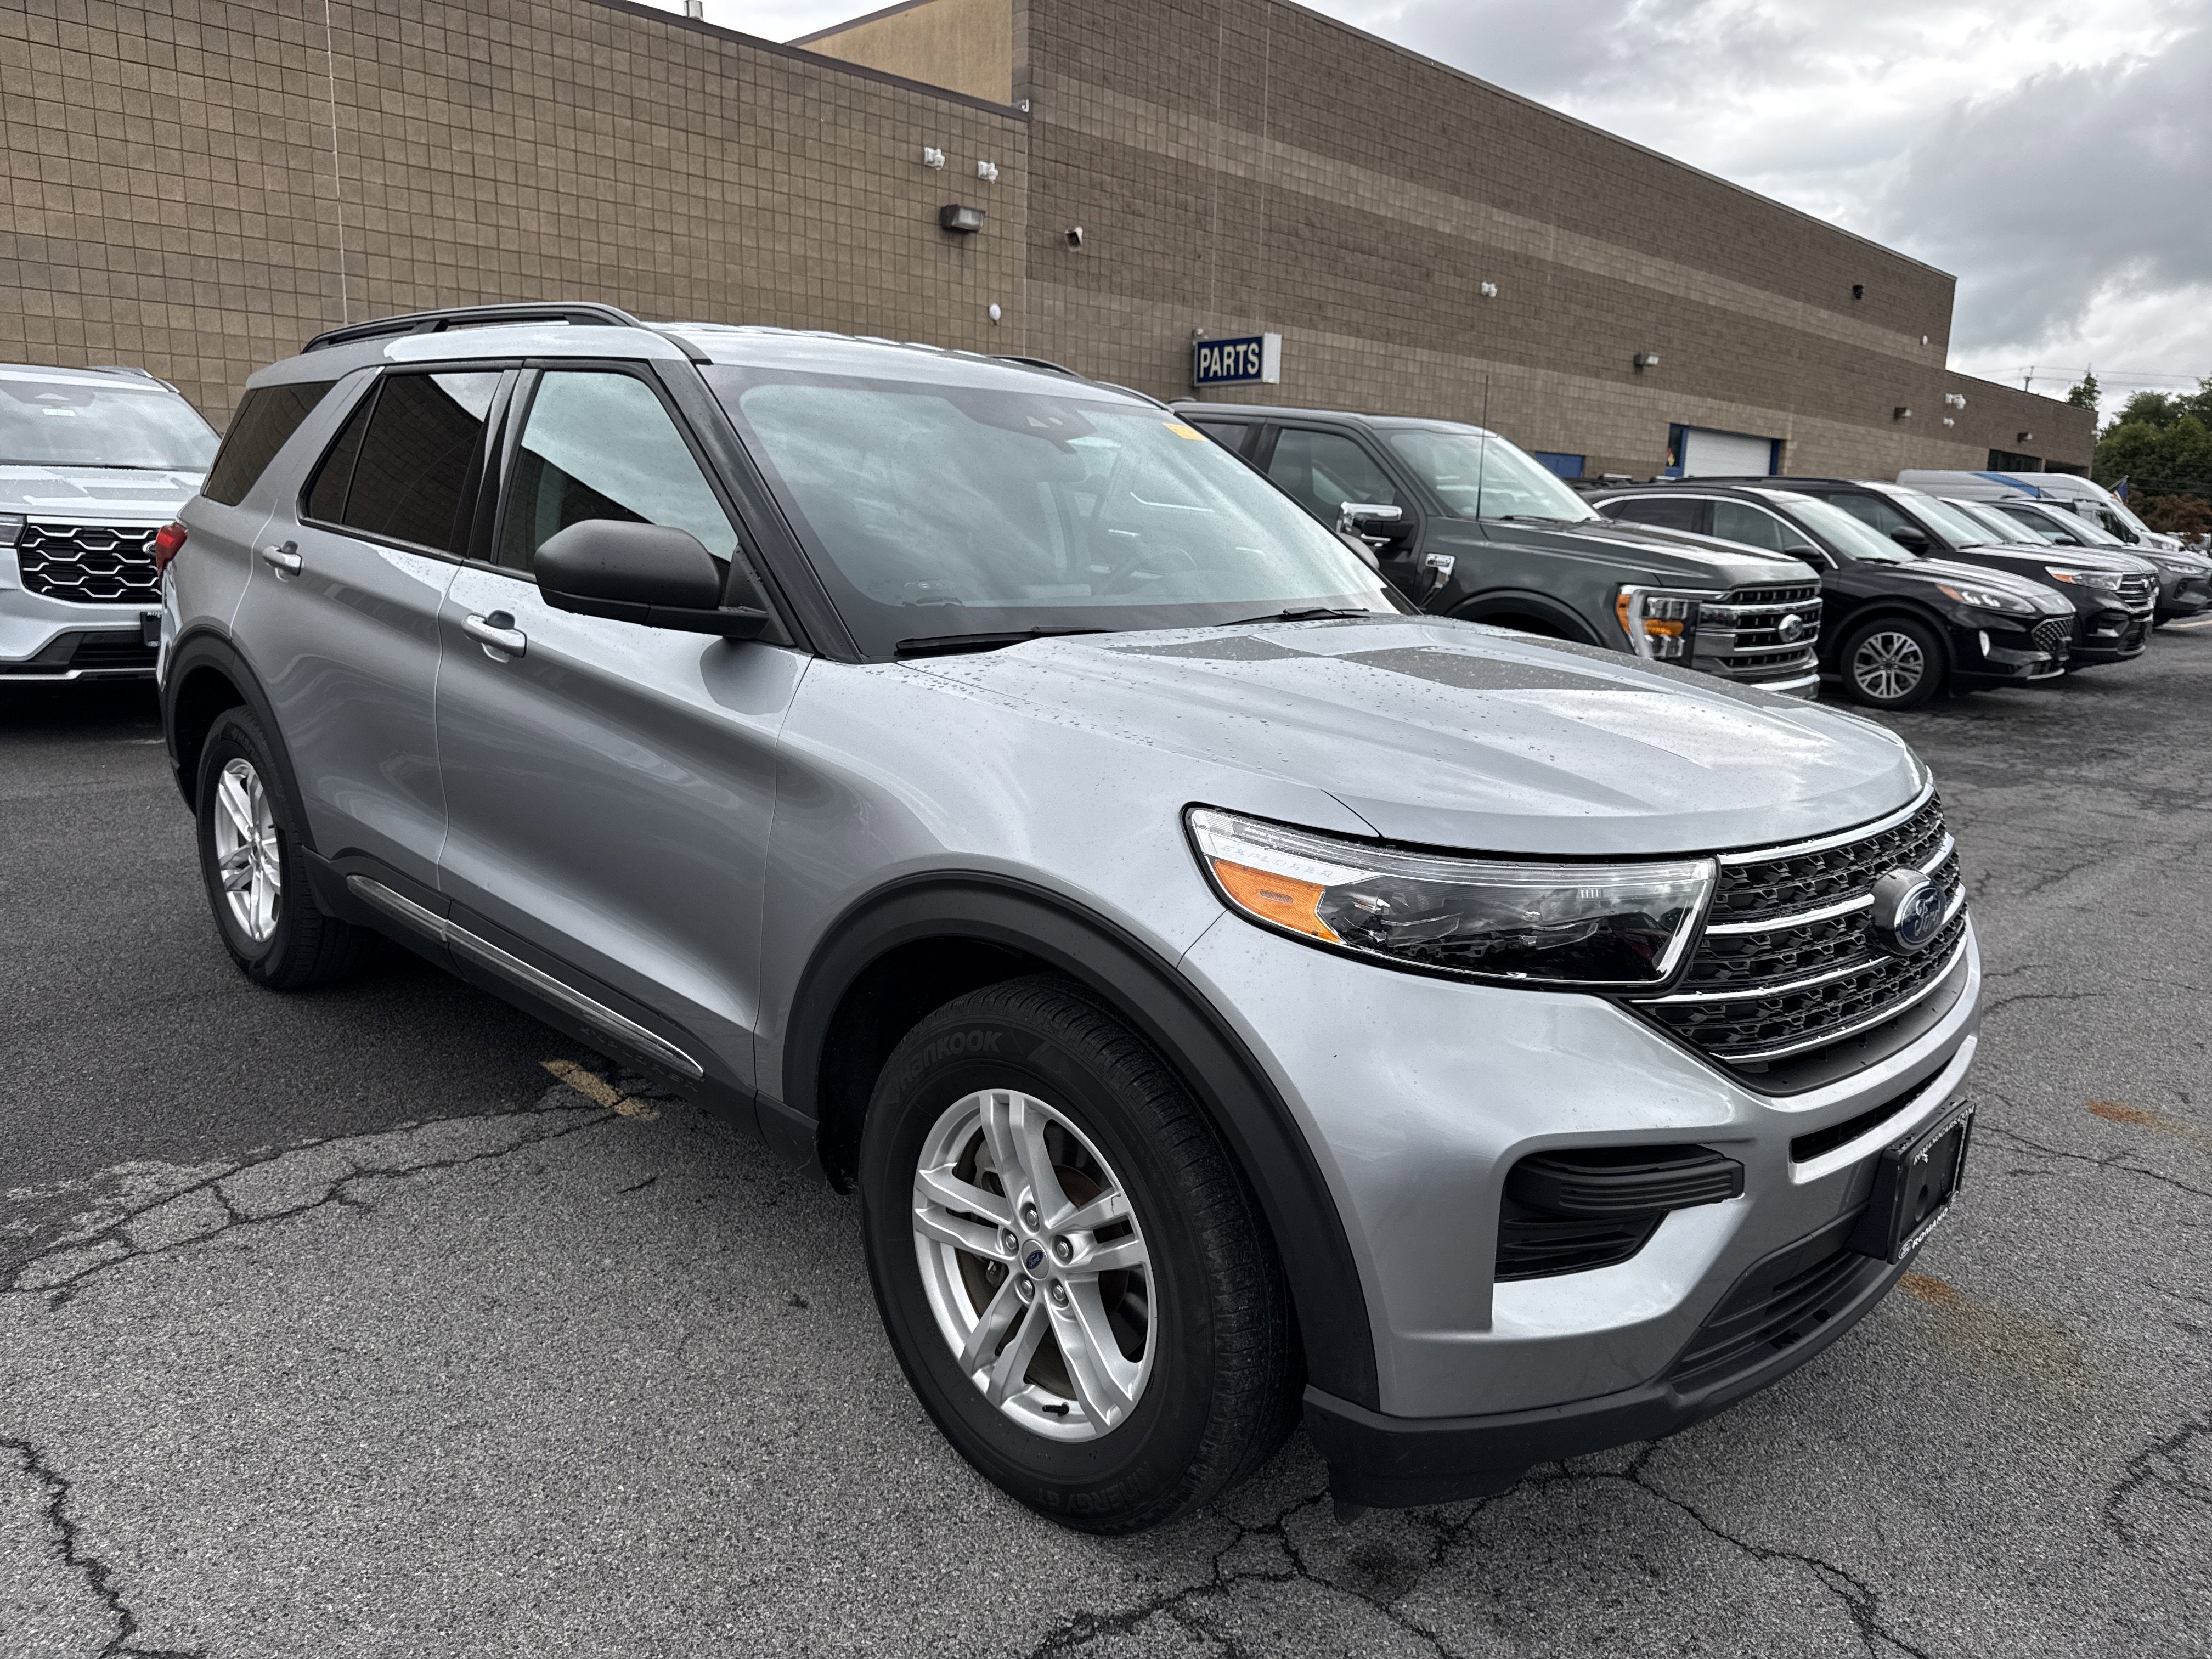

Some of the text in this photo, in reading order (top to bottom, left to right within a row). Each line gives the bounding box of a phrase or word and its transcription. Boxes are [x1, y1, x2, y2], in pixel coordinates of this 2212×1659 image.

[1200, 342, 1260, 378] PARTS
[1221, 845, 1333, 877] EXPLORER
[1912, 1207, 1948, 1249] ROMANO
